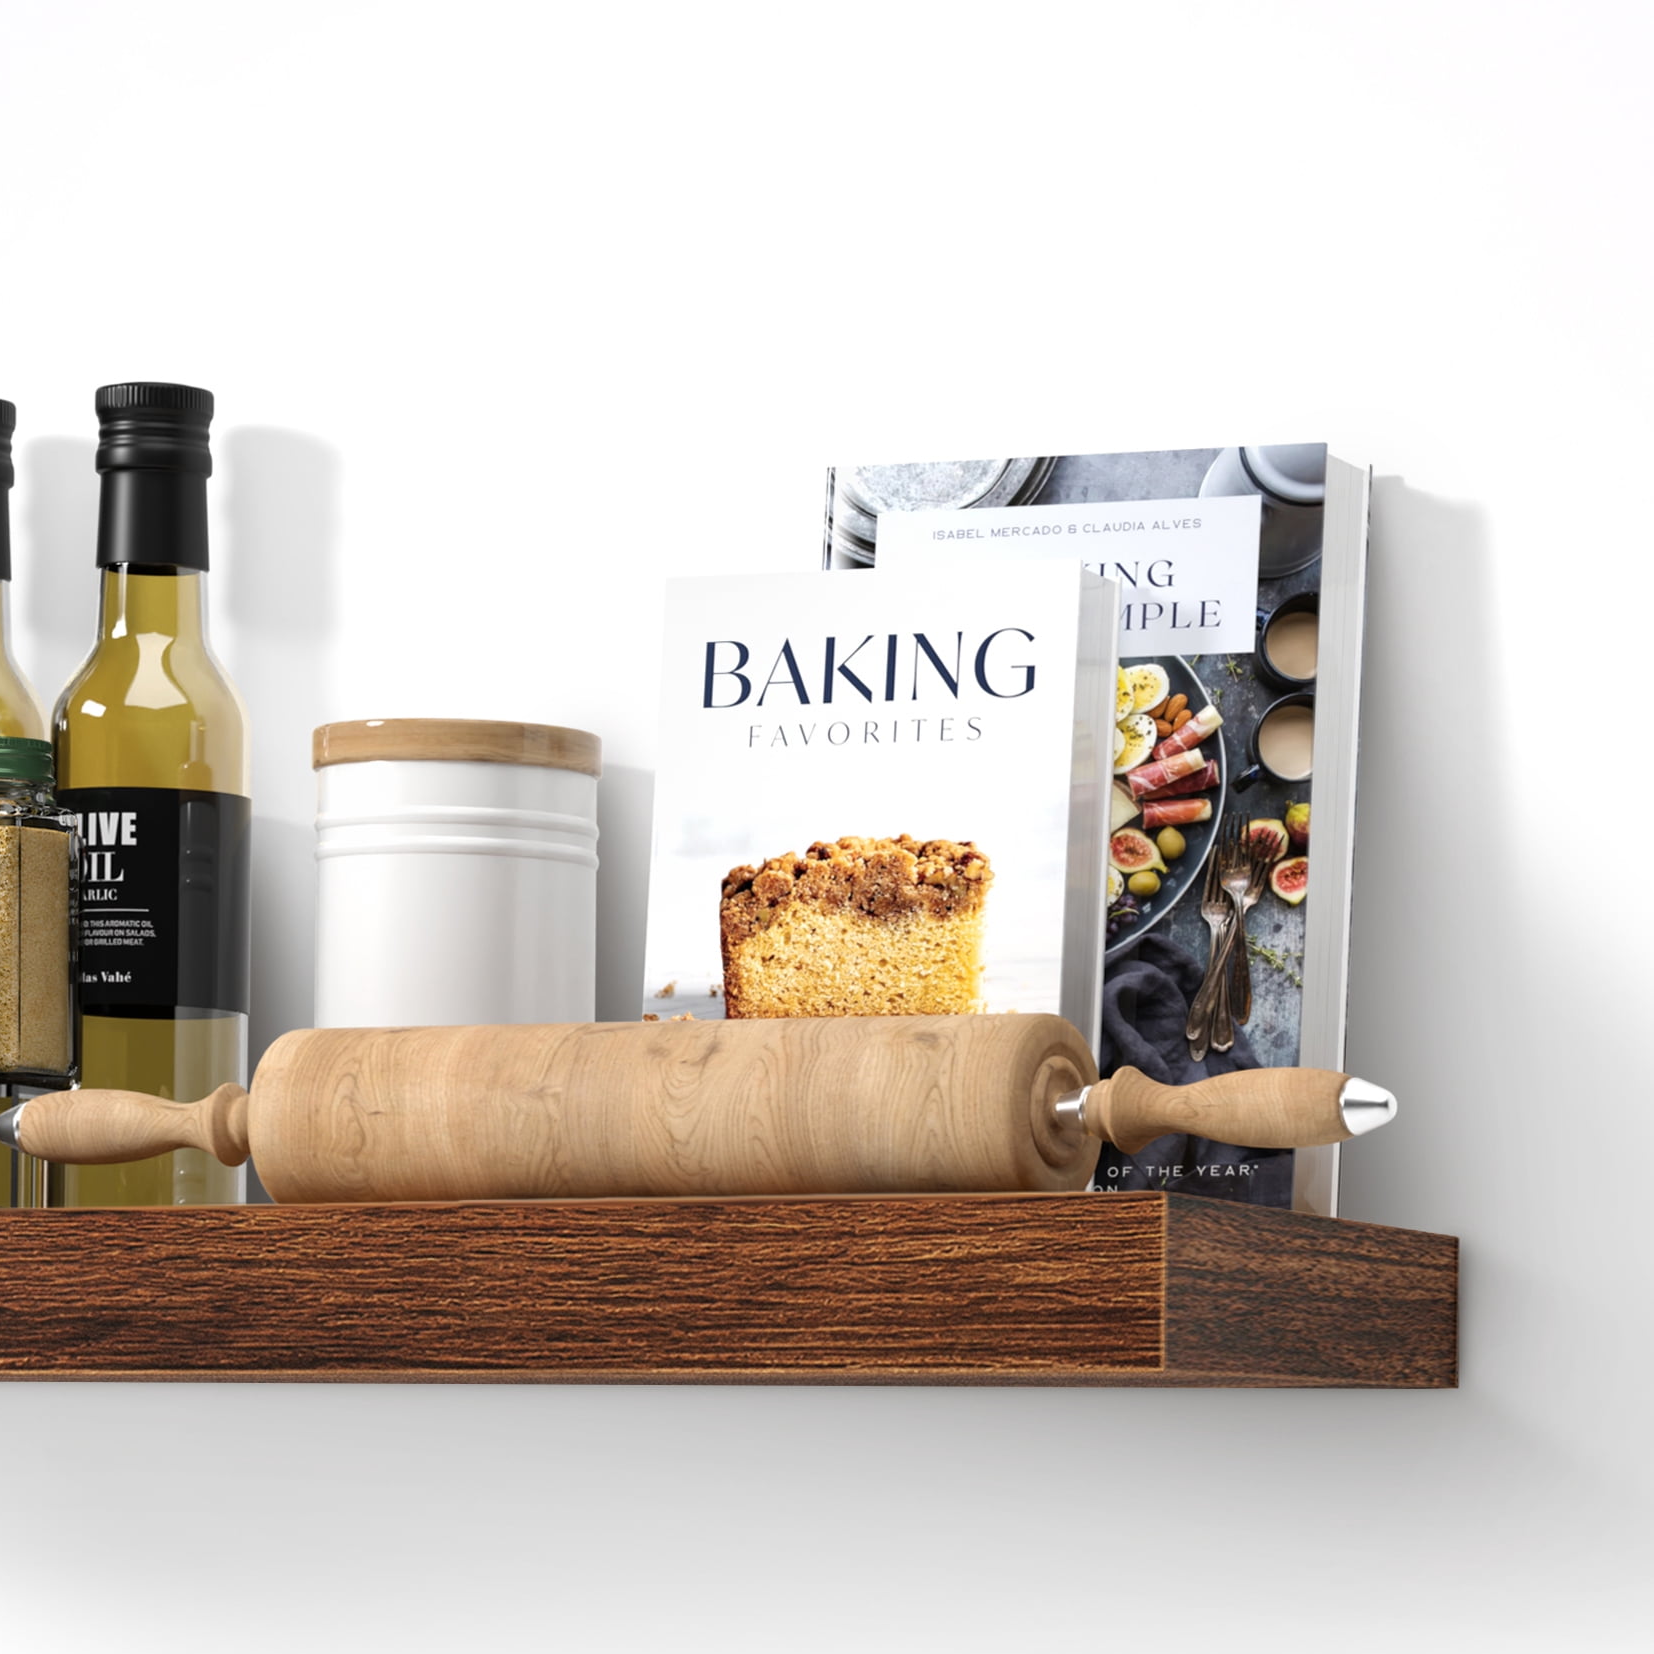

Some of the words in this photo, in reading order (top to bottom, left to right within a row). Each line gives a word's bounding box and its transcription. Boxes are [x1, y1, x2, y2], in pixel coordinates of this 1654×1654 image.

[932, 528, 985, 541] ISABEL
[990, 524, 1062, 538] MERCADO
[1082, 520, 1146, 534] CLAUDIA
[1151, 518, 1203, 530] ALVES
[1084, 559, 1175, 588] ING
[702, 627, 1036, 709] BAKING
[748, 716, 982, 749] FAVORITES
[83, 851, 124, 882] IL
[101, 971, 132, 983] Vahé
[1107, 1166, 1133, 1178] OF
[1145, 1165, 1184, 1177] THE
